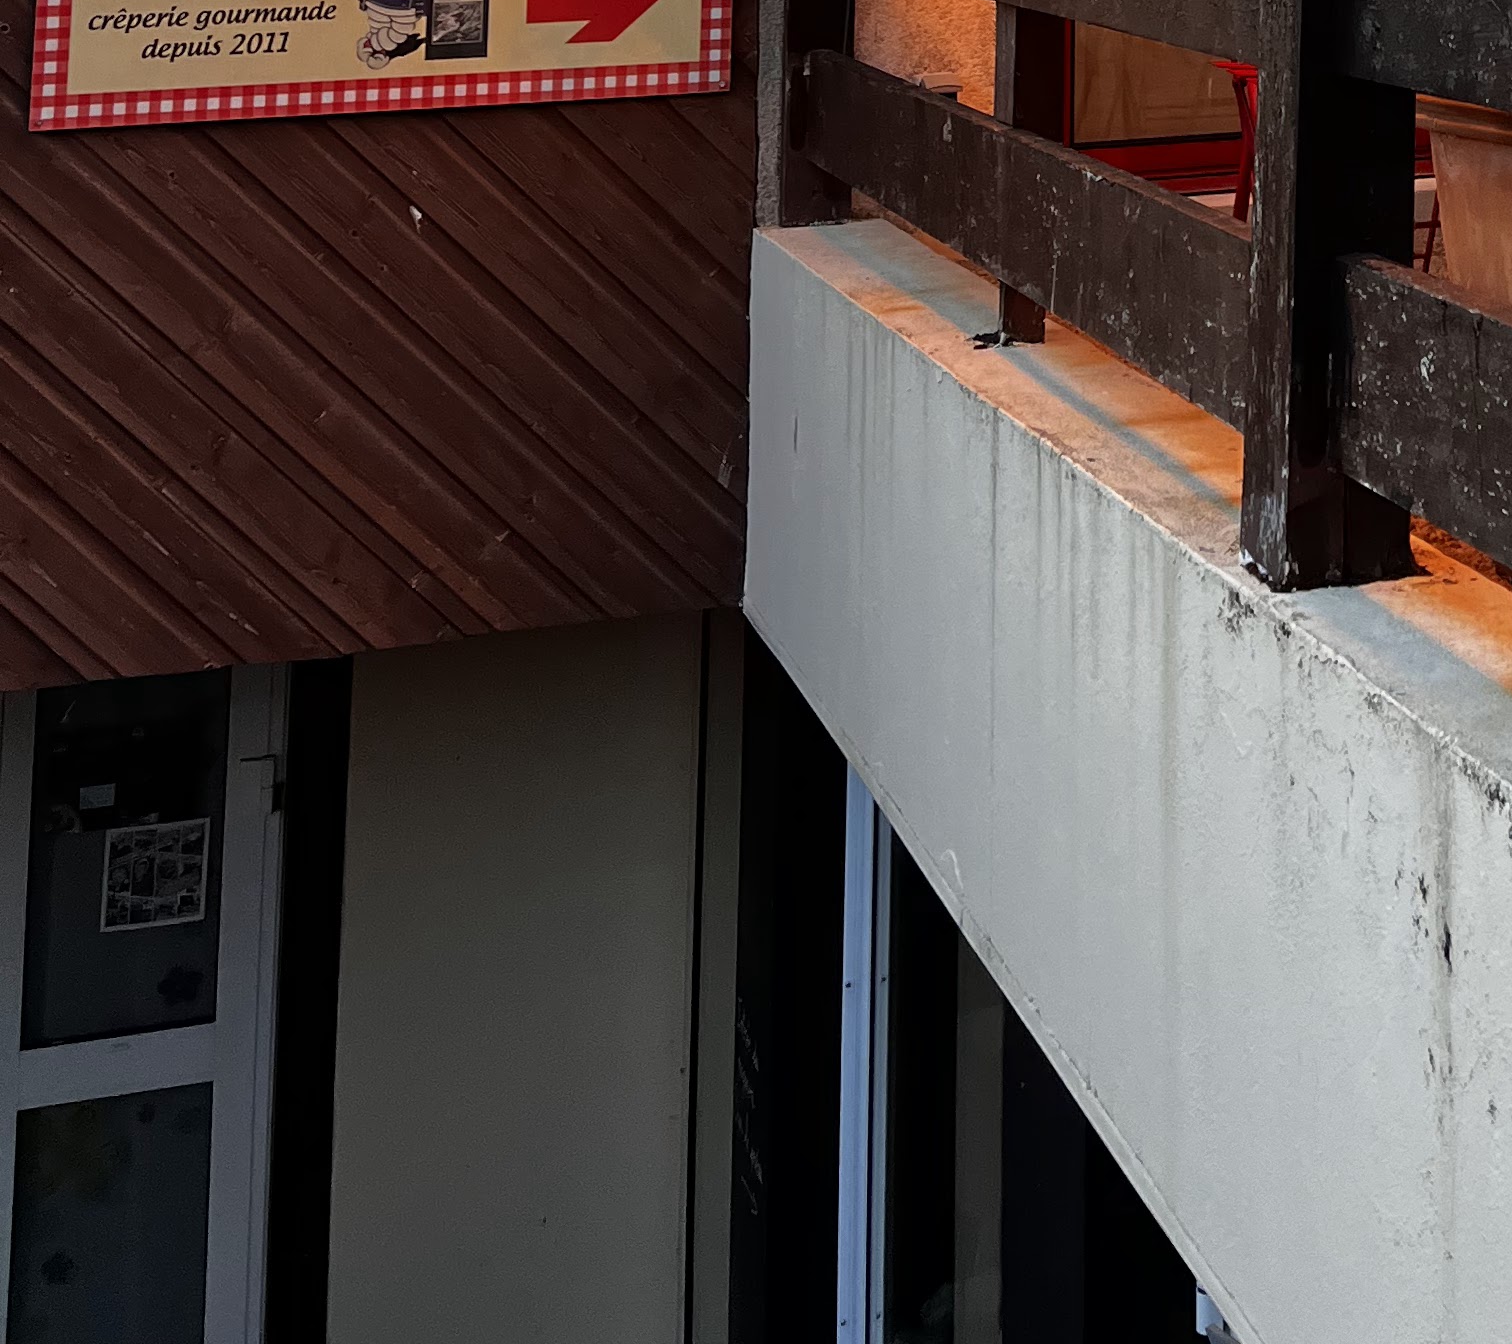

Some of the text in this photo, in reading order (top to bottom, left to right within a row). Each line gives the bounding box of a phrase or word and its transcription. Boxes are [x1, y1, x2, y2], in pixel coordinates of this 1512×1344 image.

[88, 0, 337, 34] crêperie gourmande
[141, 31, 290, 63] depuis 2011
